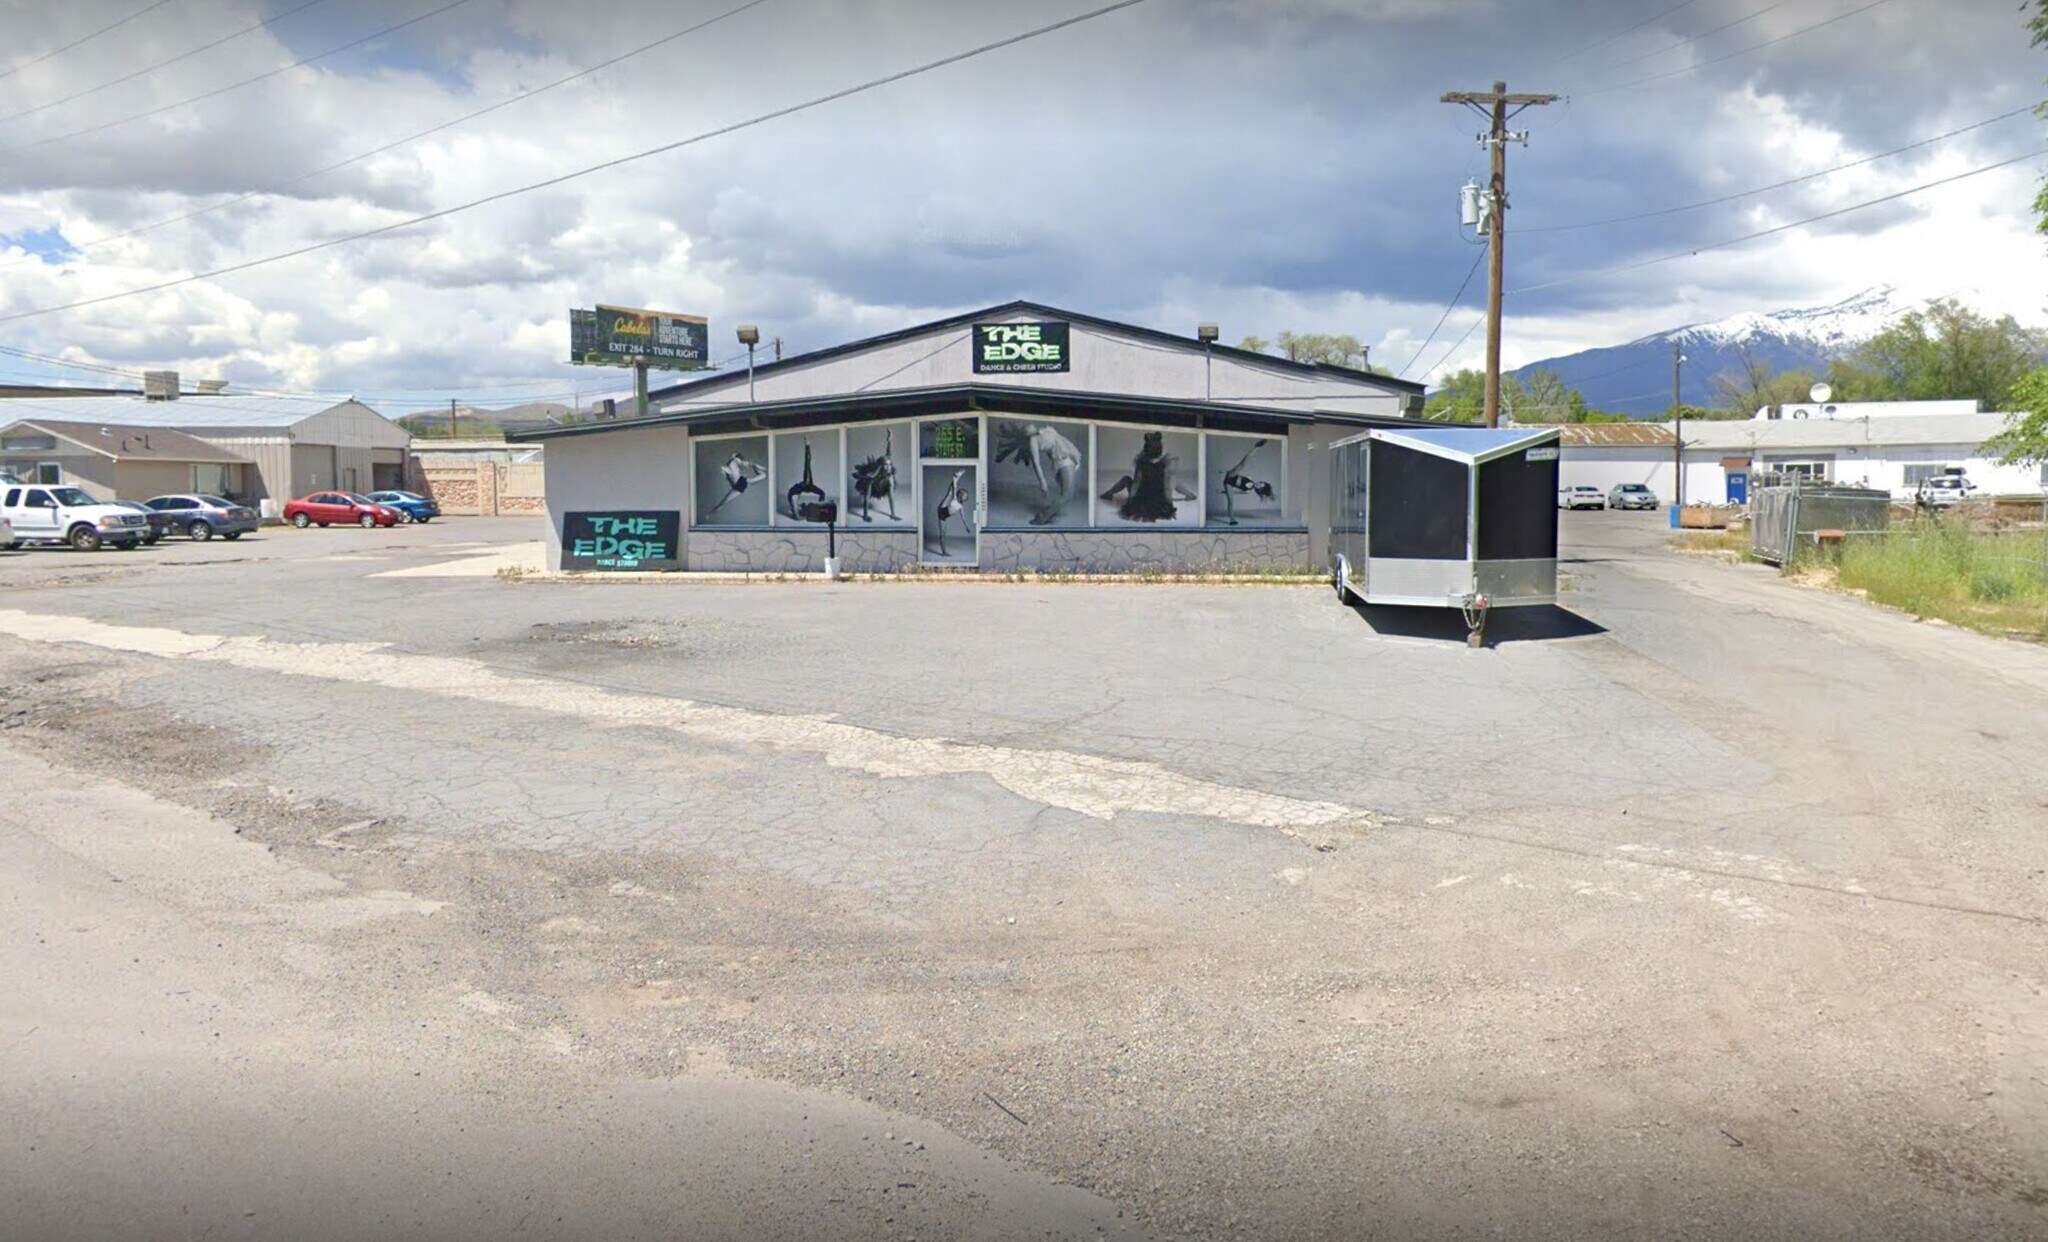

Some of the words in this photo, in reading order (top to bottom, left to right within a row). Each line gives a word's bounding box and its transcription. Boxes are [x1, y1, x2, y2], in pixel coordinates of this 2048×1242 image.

[659, 326, 688, 336] ADVENTURE
[981, 325, 1042, 342] THE
[659, 334, 678, 345] STARTS
[679, 336, 692, 346] HERE
[609, 342, 626, 352] EXIT
[629, 344, 644, 354] 284
[652, 346, 675, 357] TURN
[675, 348, 699, 359] RIGHT
[983, 342, 1061, 361] EDGE
[587, 517, 658, 536] THE
[573, 537, 666, 560] EDGE
